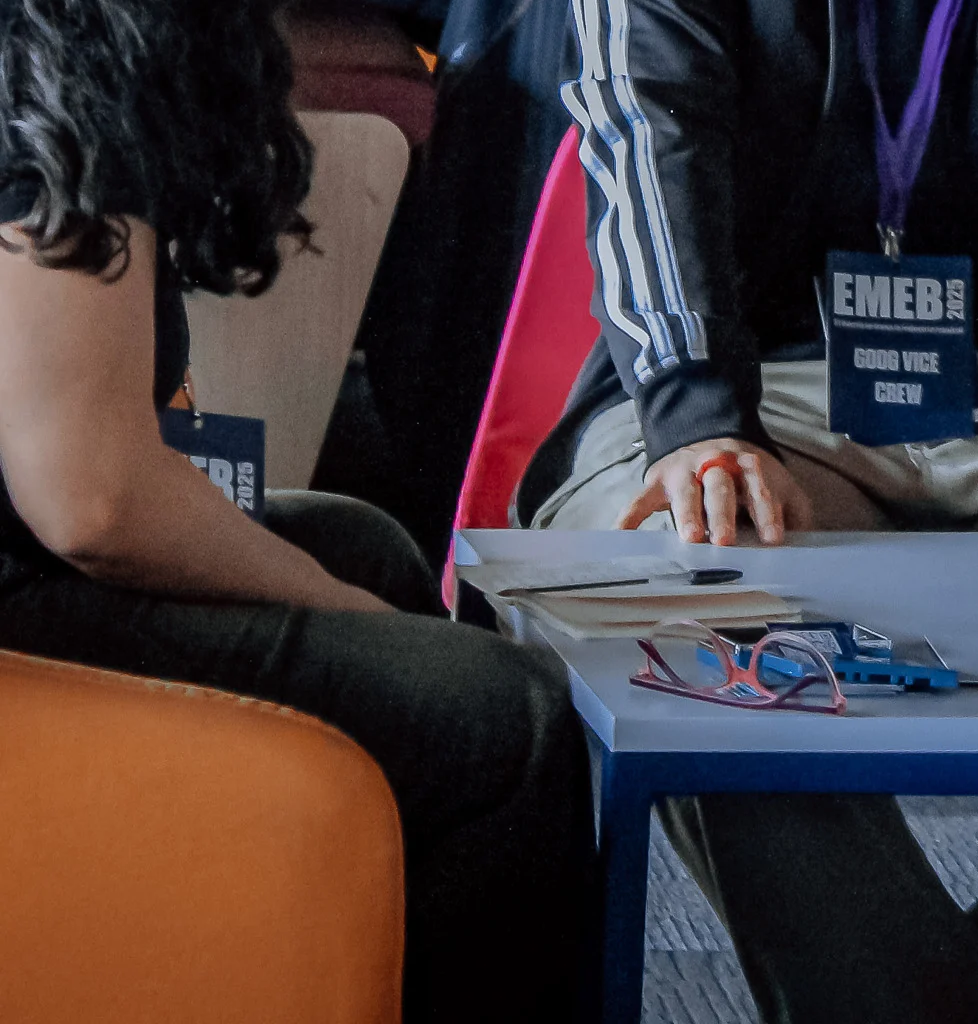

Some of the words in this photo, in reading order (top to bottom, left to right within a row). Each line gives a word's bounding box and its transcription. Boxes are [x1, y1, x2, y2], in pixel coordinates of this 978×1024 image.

[833, 272, 943, 321] EMEB
[946, 279, 965, 320] 2025
[874, 381, 922, 405] CREW
